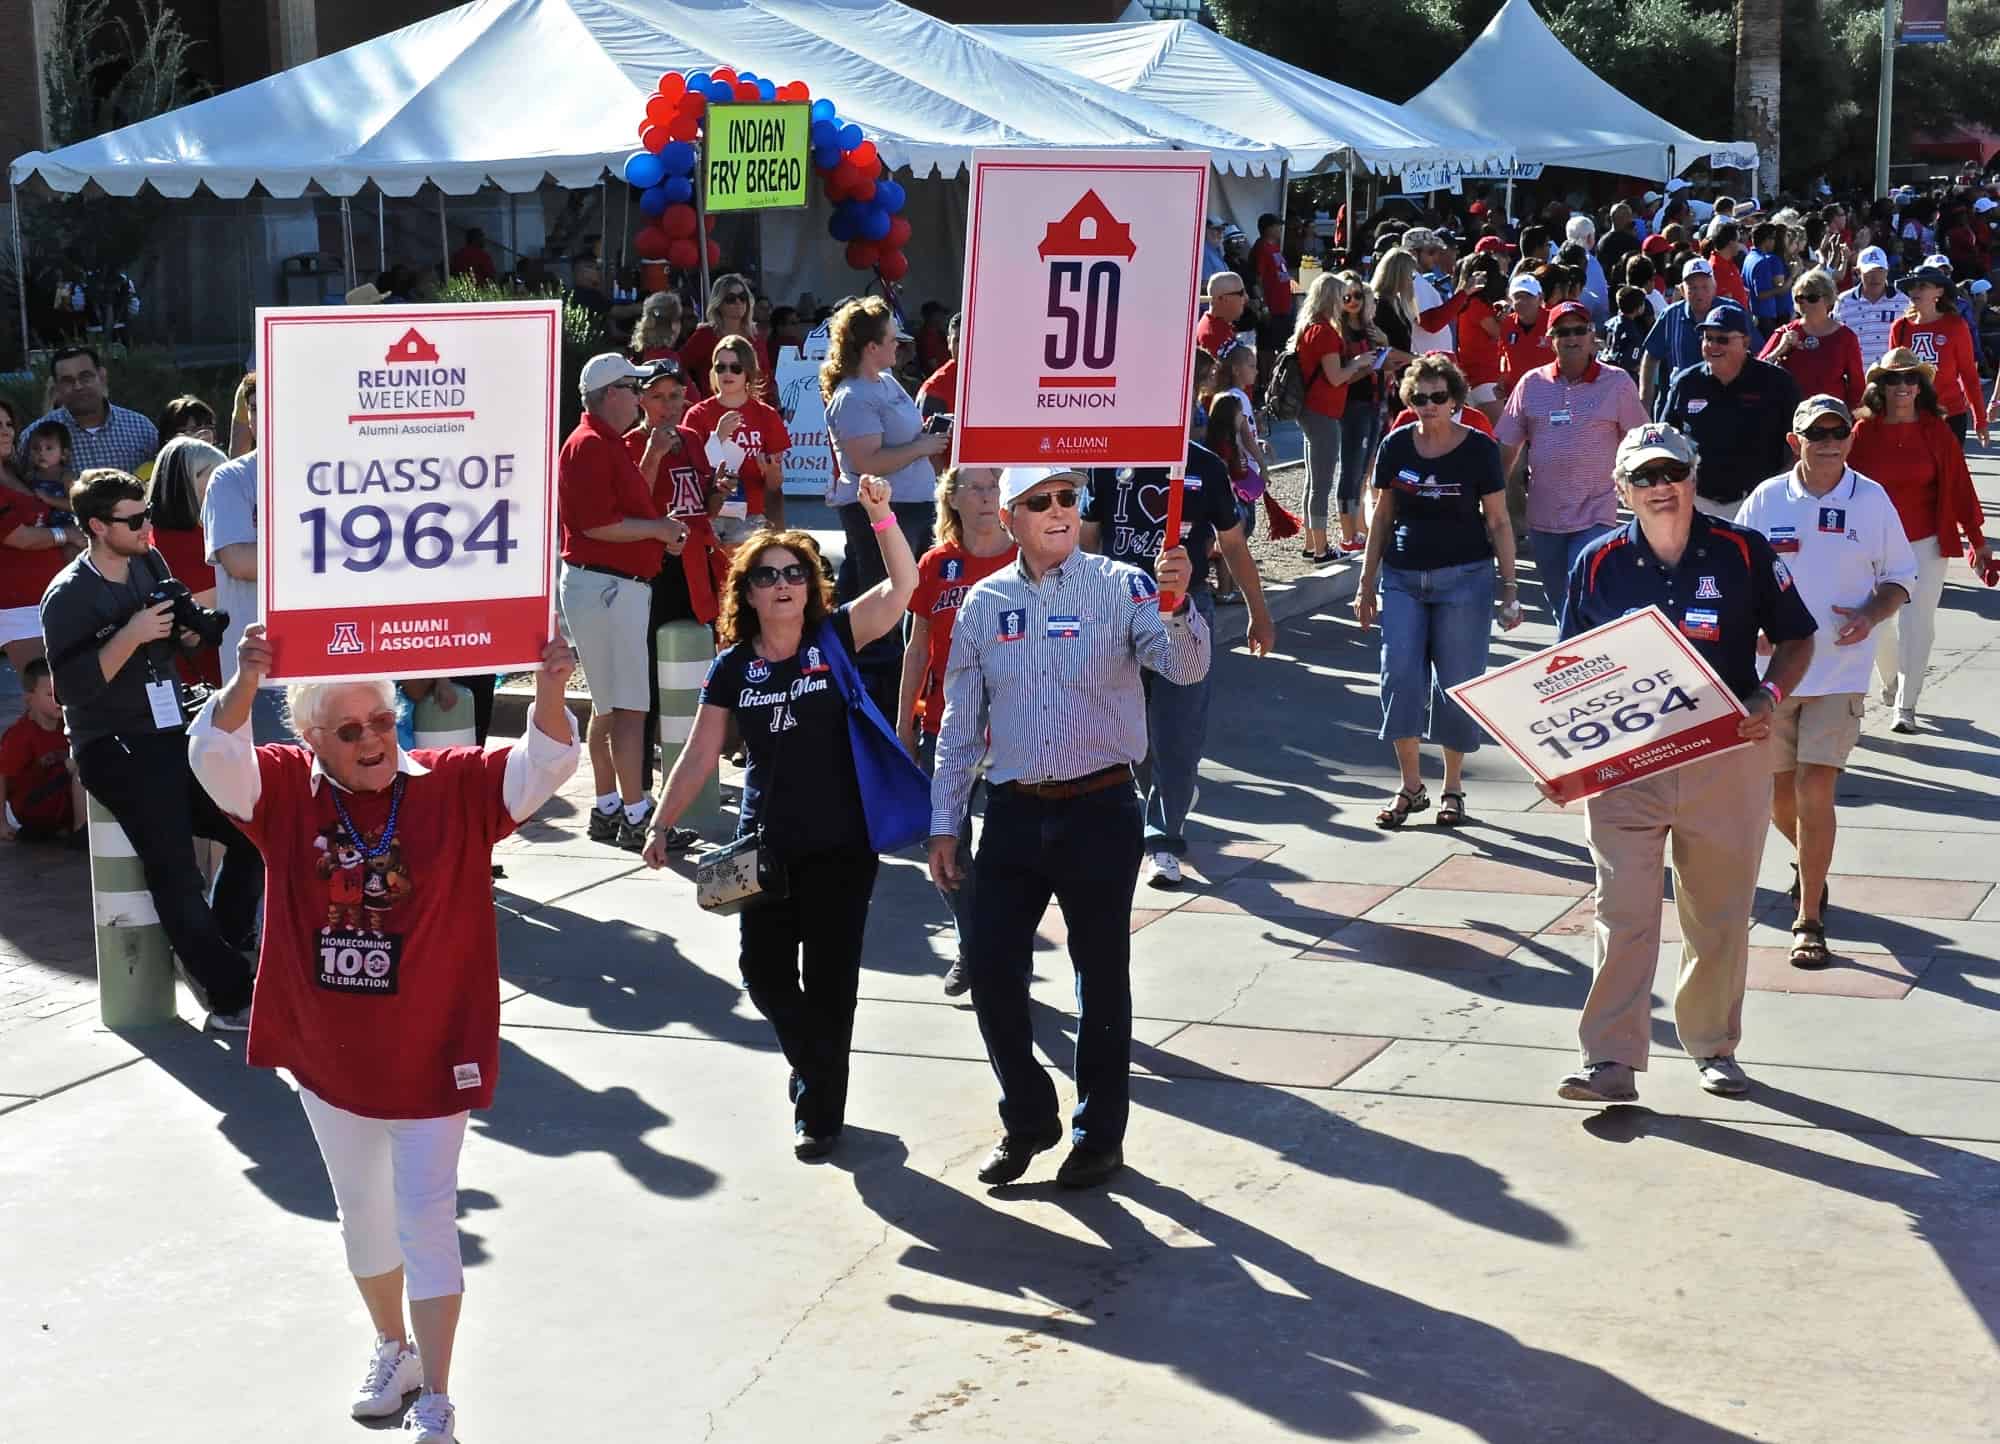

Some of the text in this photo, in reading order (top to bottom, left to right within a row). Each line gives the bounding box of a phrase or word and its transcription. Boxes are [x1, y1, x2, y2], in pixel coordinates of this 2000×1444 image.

[729, 119, 785, 153] INDIAN
[710, 158, 800, 195] FRY BREAD
[1044, 261, 1121, 370] 50
[358, 367, 466, 388] REUNION
[358, 388, 466, 410] WEEKEND
[1037, 393, 1116, 409] REUNION
[358, 422, 465, 436] Alumni Association
[1056, 436, 1108, 449] ALUMNI
[306, 454, 515, 496] CLASS OF
[783, 450, 827, 471] Rosa
[299, 499, 518, 574] 1964
[380, 618, 449, 635] ALUMNI
[380, 632, 492, 651] ASSOCIATION
[1533, 653, 1611, 690] REUNION
[1539, 661, 1616, 695] WEEKEND
[738, 675, 828, 707] Arizona Mom
[1530, 690, 1624, 735] CLASS
[1632, 669, 1673, 693] OF
[1537, 686, 1700, 760] 1964
[1628, 742, 1677, 764] ALUMNI
[1633, 737, 1713, 769] ASSOCIATION
[320, 937, 393, 949] HOMECOMING
[320, 947, 391, 978] 100
[320, 973, 390, 988] CELEBRATION
